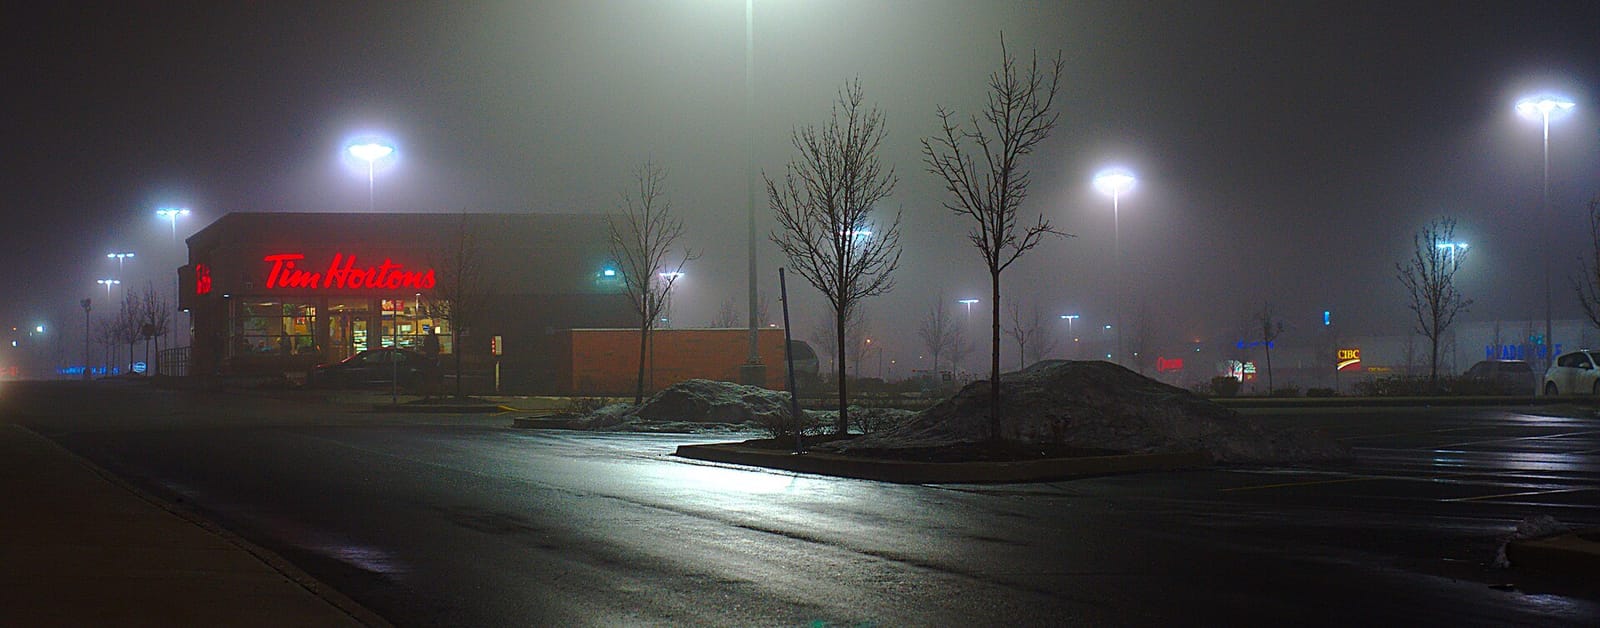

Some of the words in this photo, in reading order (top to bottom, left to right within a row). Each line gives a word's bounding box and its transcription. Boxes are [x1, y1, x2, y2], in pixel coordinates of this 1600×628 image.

[264, 253, 321, 289] Tim
[323, 252, 436, 290] Hortons
[1337, 349, 1360, 359] CIBC
